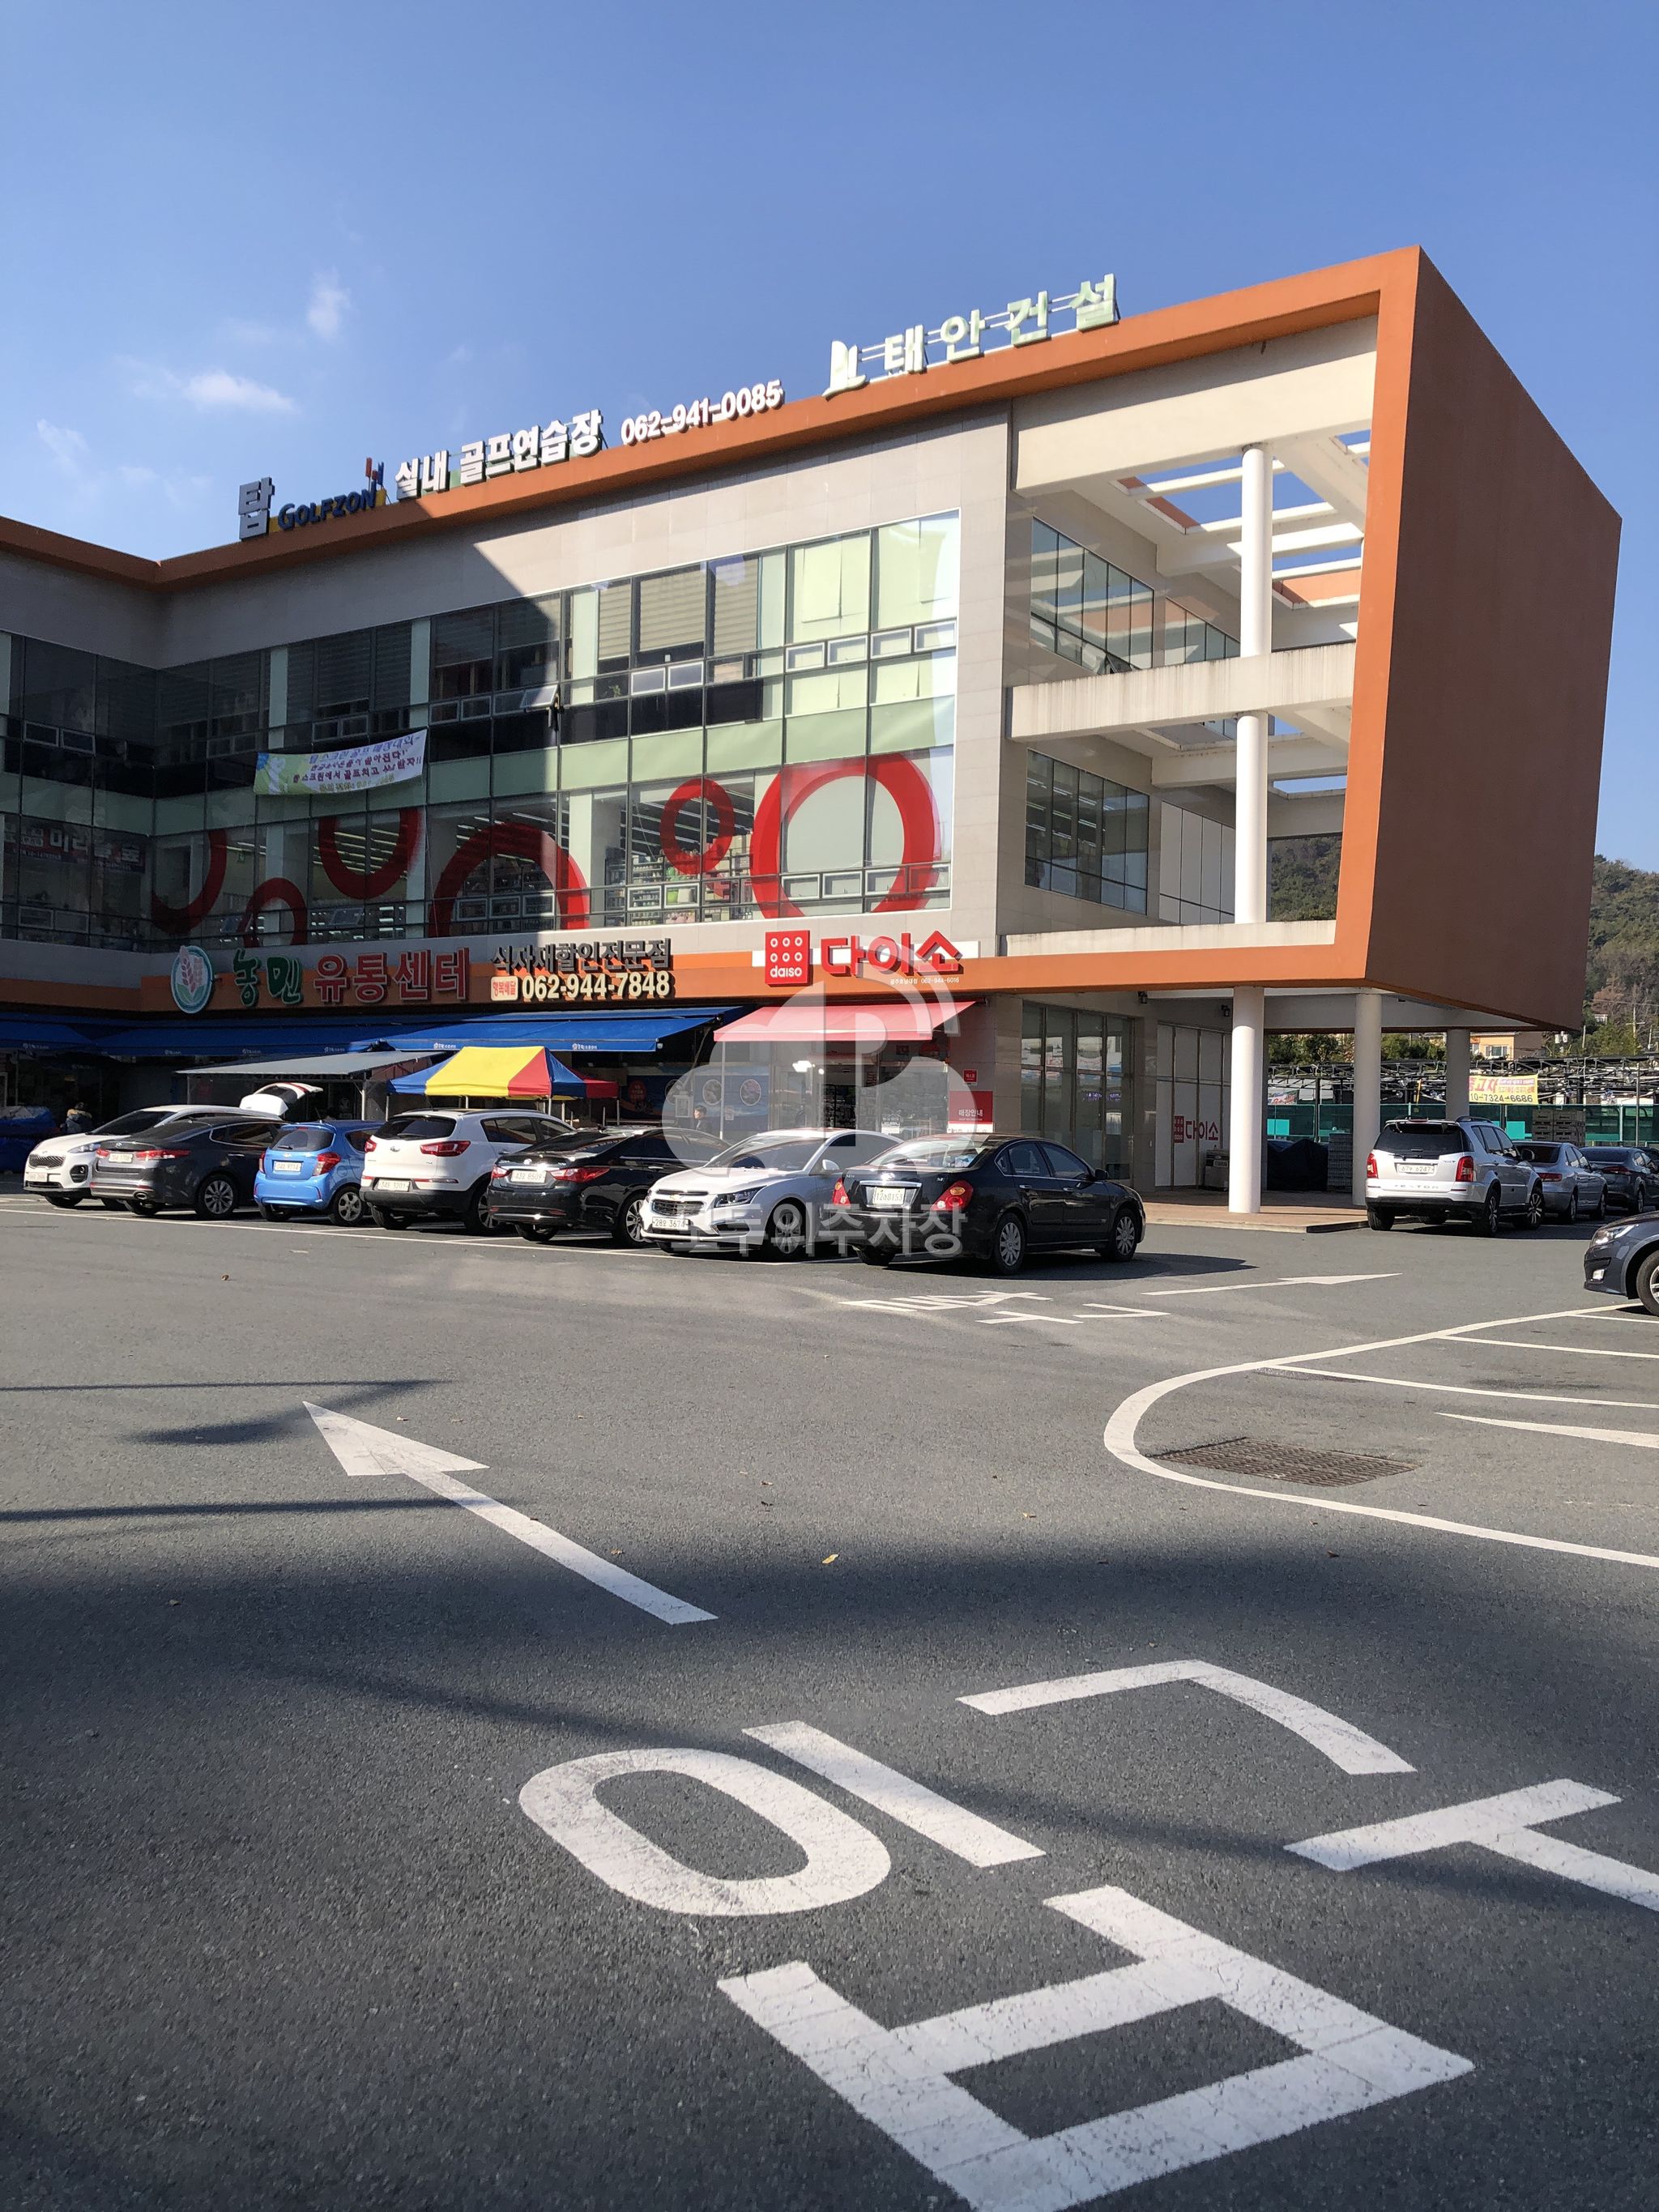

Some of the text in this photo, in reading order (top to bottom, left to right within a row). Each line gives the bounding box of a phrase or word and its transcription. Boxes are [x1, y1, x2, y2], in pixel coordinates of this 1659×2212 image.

[884, 273, 1116, 373] 태안건설
[238, 379, 785, 541] 탑 GOLFZON 실내 골프연습장 062-941-0085
[491, 937, 672, 974] 식자재할인전문점
[770, 965, 803, 978] daiso
[820, 930, 962, 977] 다이소
[232, 947, 470, 1007] 농민 유통센터
[493, 970, 671, 999] 행복배달 062-944-7848
[1470, 1093, 1533, 1102] 10-7324-6686
[1185, 1119, 1219, 1141] 다이소
